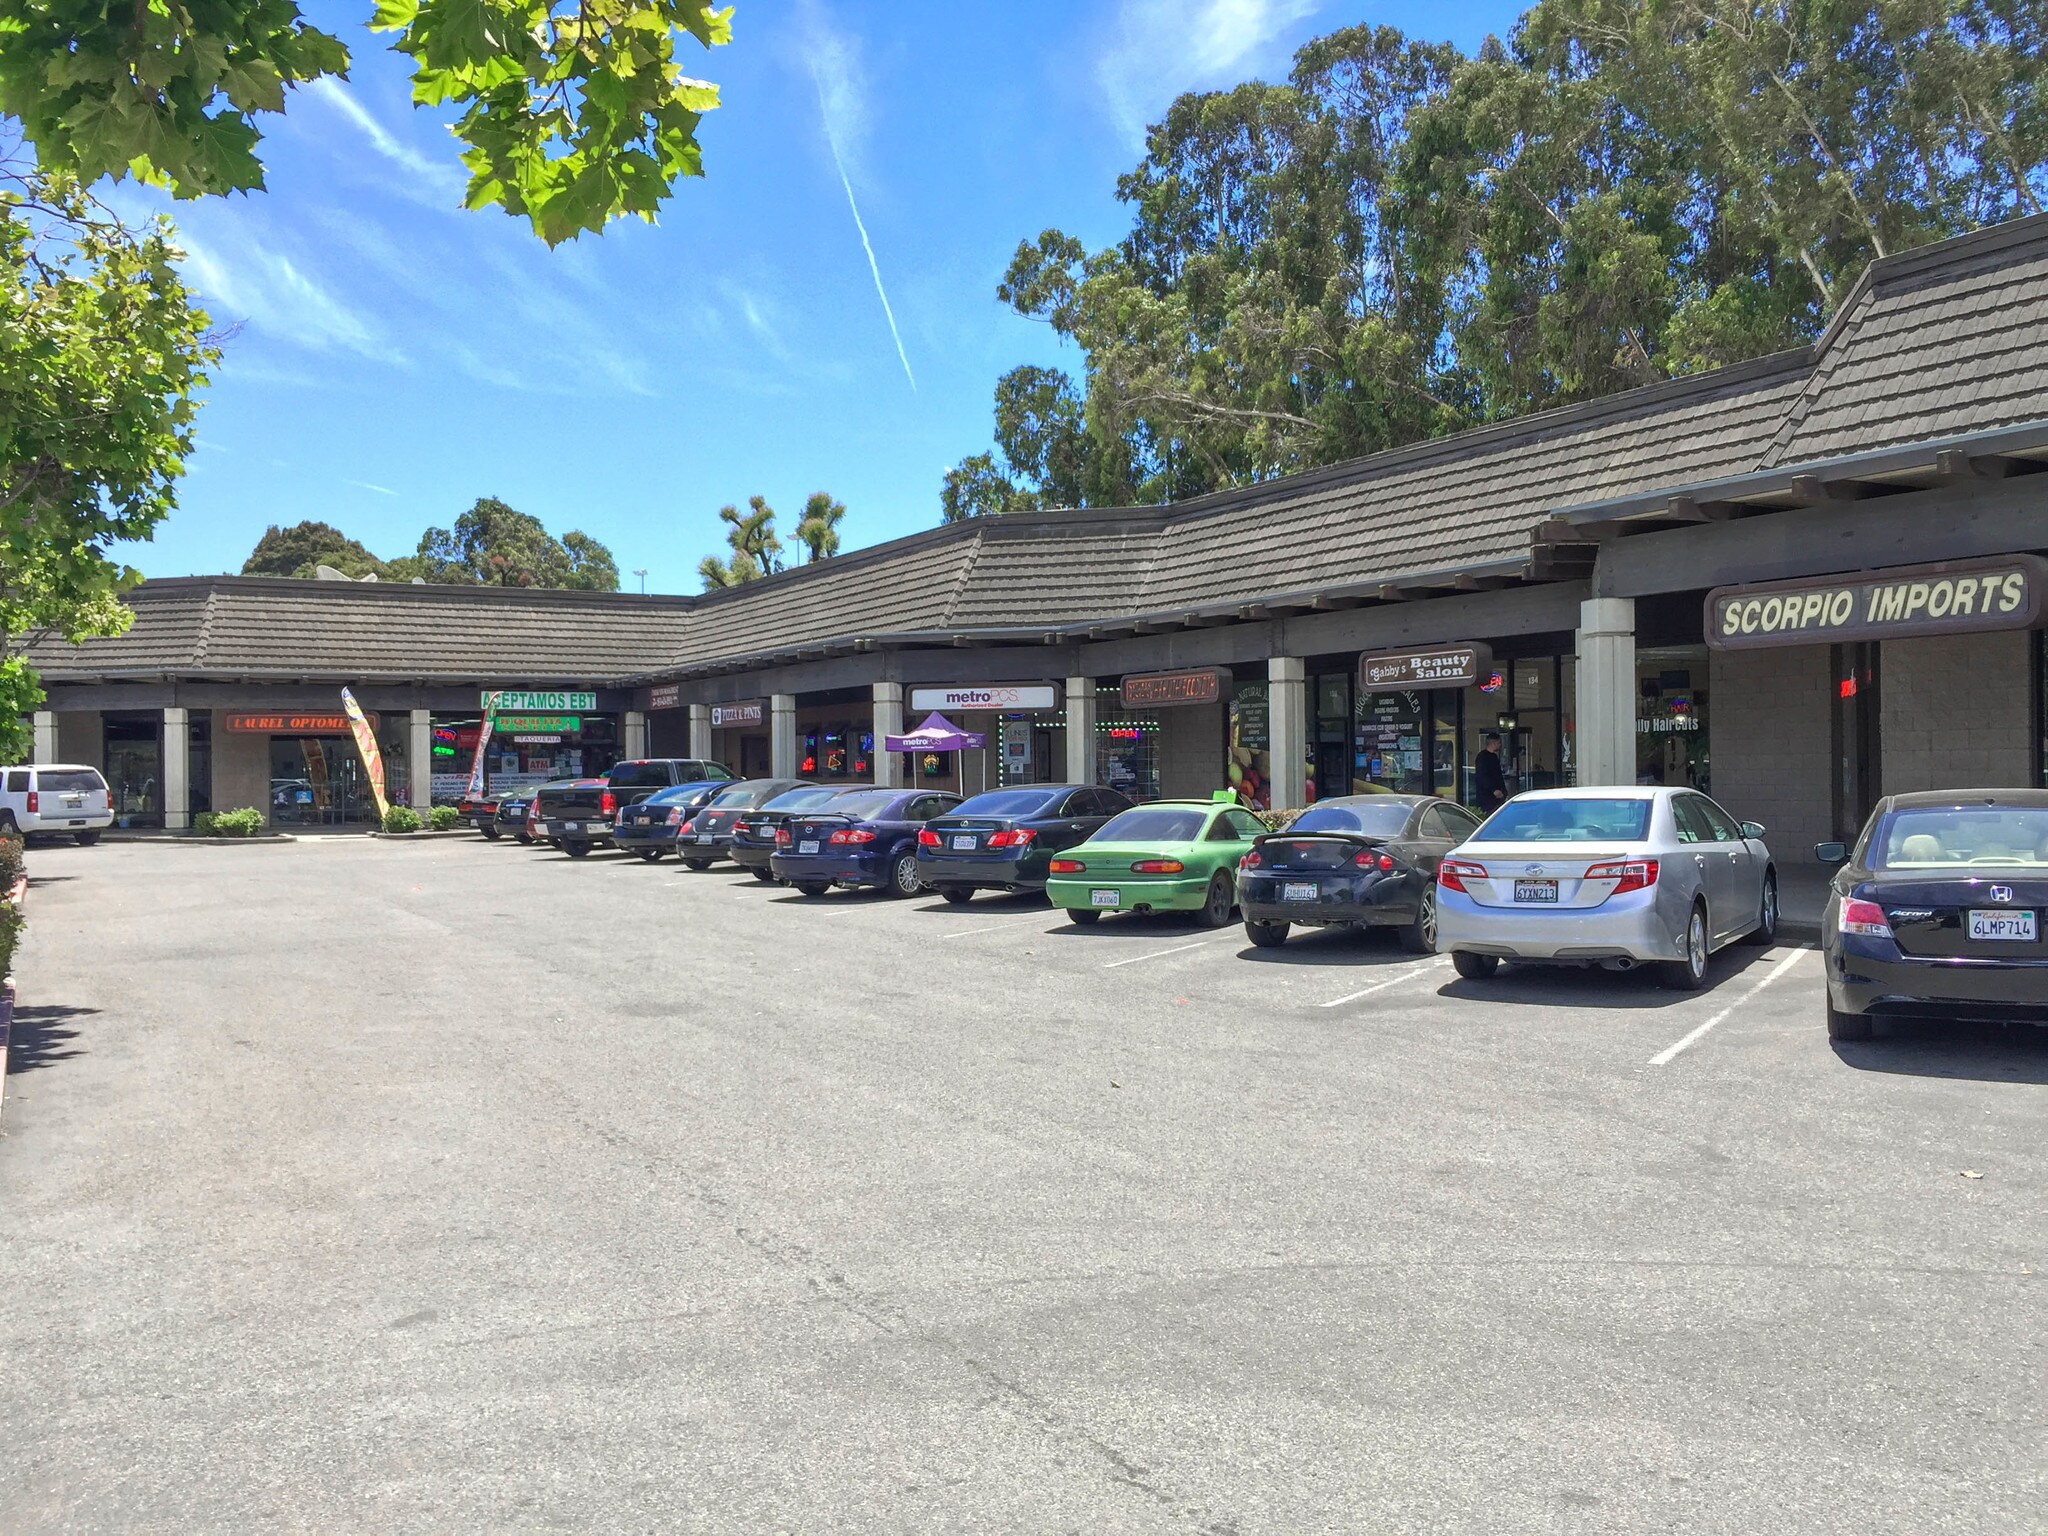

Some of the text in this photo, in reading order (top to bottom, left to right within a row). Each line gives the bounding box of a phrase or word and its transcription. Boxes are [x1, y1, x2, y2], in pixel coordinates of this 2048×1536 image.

[1722, 572, 2025, 636] SCORPIO IMPORTS
[1410, 654, 1470, 668] Beauty
[1370, 659, 1406, 682] Gabby's
[1416, 667, 1463, 679] Salon
[569, 693, 595, 709] EBT
[946, 689, 1018, 703] metroPCS
[722, 708, 738, 721] PIZZA
[744, 706, 761, 720] PINTS
[233, 718, 350, 729] LAUREL OPTOME
[1653, 716, 1699, 732] Haircuts
[520, 735, 561, 743] TAQUERIA
[1111, 729, 1138, 738] OPEN
[902, 736, 942, 746] metroPCS
[529, 760, 549, 769] ATM
[1517, 888, 1555, 899] 6YXN213
[1982, 911, 2020, 920] California
[1973, 921, 2031, 935] 6LMP714
